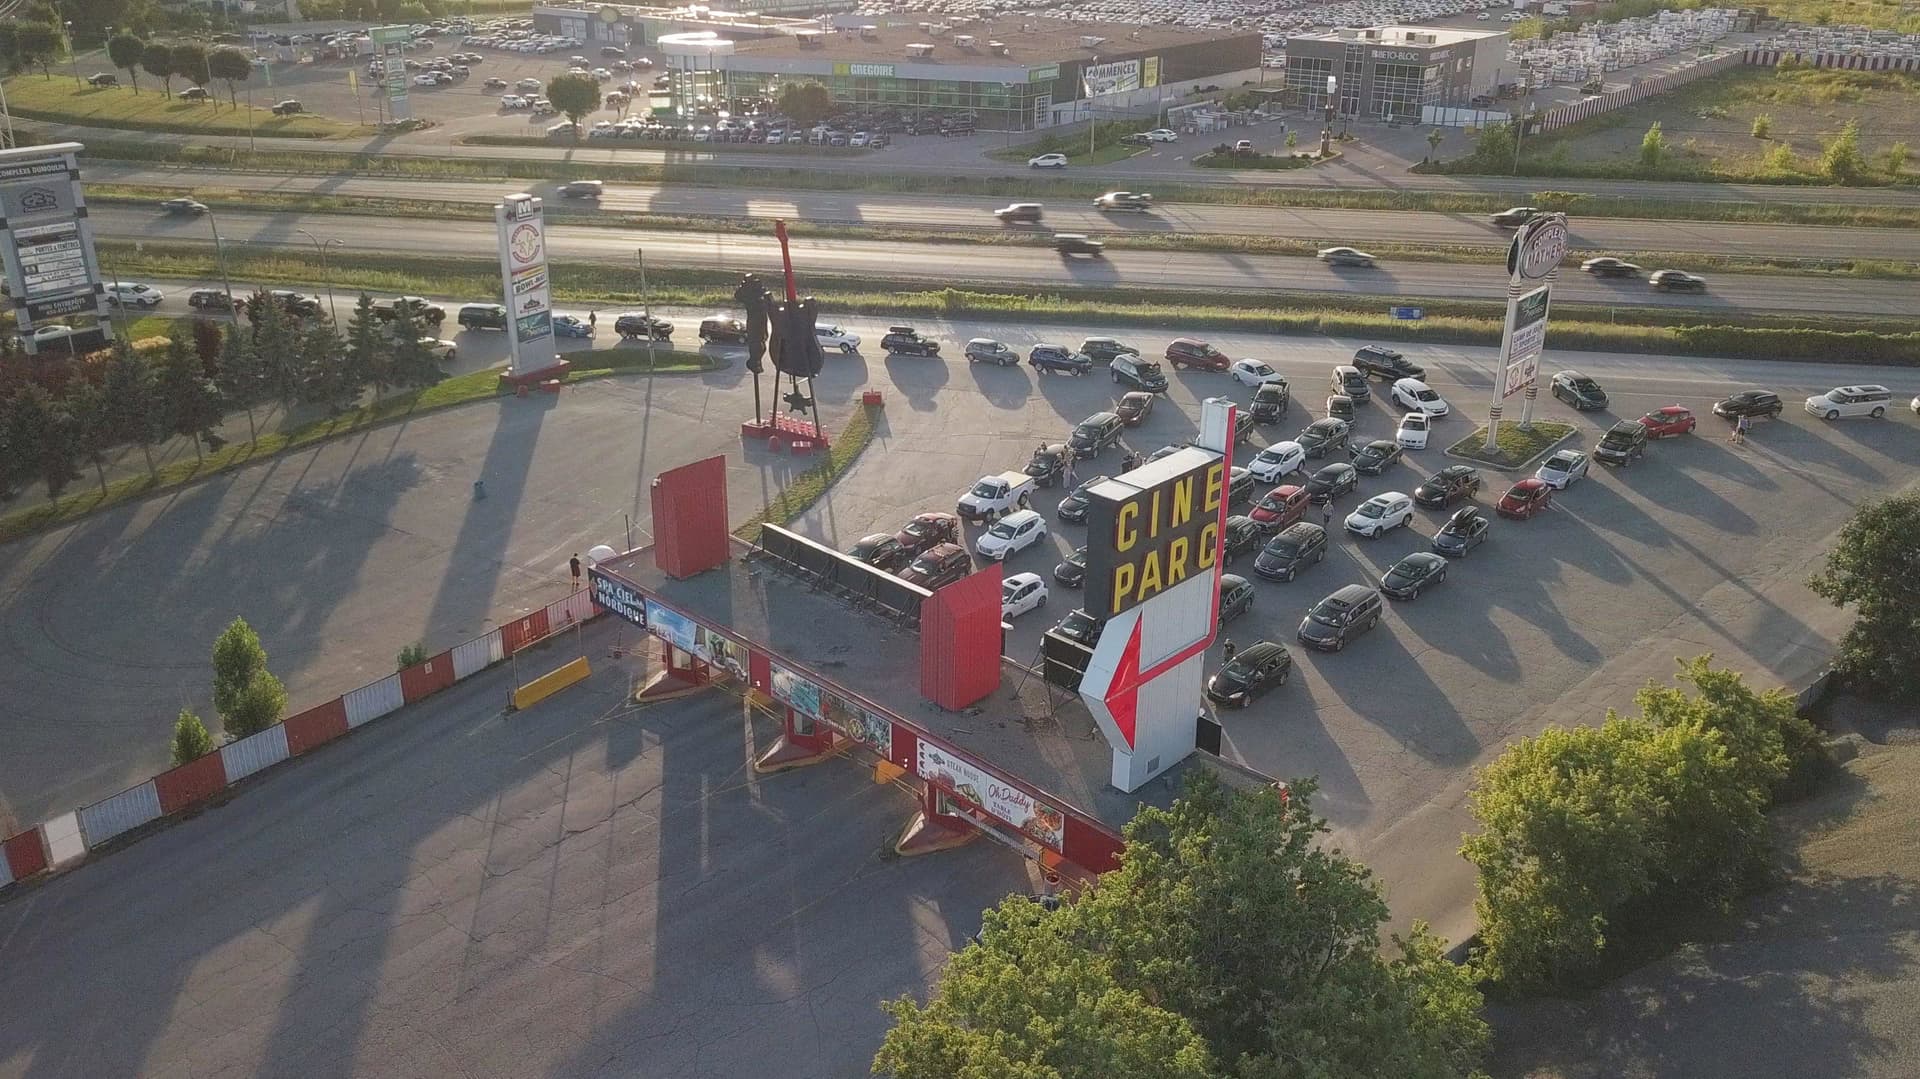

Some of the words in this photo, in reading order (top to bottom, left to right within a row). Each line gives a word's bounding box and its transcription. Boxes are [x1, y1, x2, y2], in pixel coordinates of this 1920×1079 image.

[850, 64, 895, 77] GREGOIRE
[1115, 463, 1224, 552] CINE
[1112, 521, 1217, 613] PARC
[597, 577, 614, 595] SPA
[616, 587, 634, 605] CIEL
[598, 592, 645, 625] NORDIQUE
[988, 783, 1000, 798] Oh
[1001, 787, 1032, 814] Daddy
